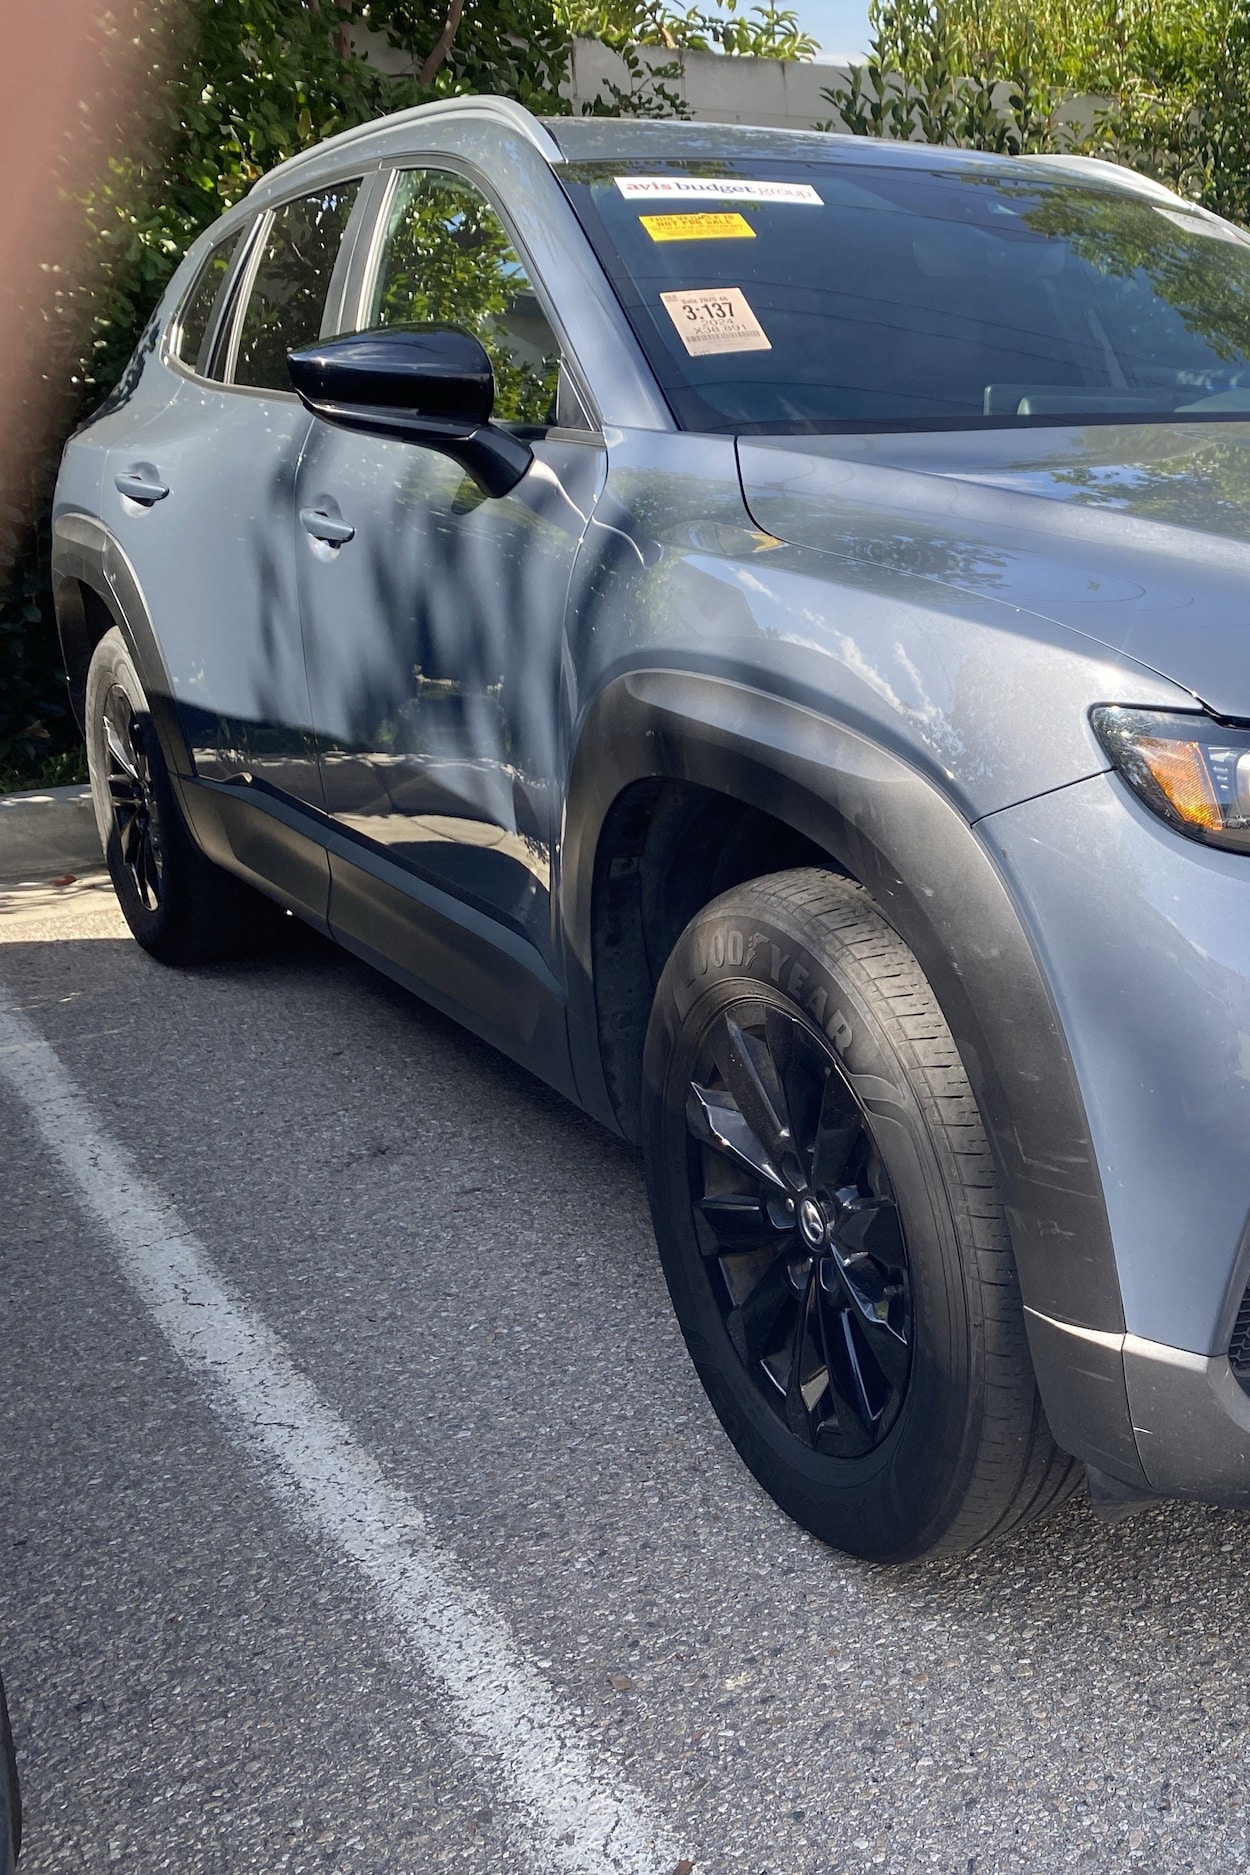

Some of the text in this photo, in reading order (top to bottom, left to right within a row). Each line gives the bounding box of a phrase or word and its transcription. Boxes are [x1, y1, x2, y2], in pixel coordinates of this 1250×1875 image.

[626, 181, 812, 199] avis budget group
[700, 318, 734, 327] 2024
